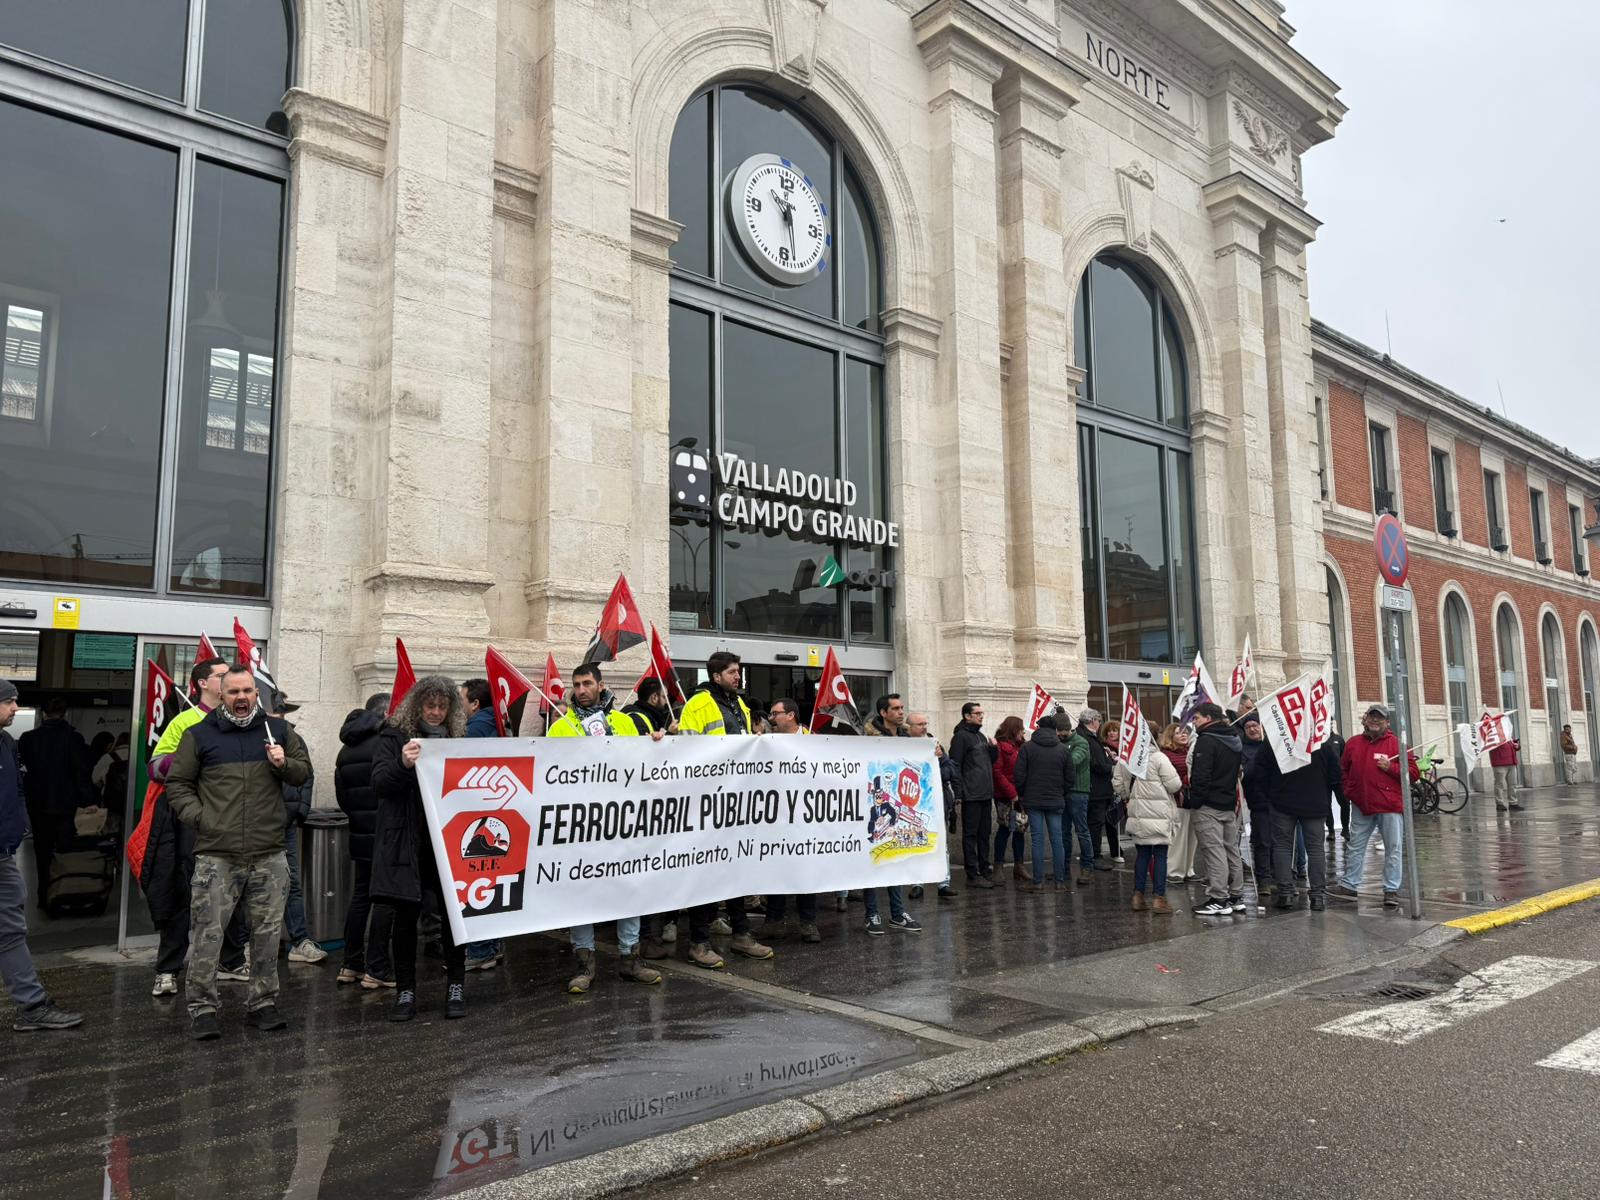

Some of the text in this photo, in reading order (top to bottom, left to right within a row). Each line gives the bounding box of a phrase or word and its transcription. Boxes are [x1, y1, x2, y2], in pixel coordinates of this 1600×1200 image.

[1086, 32, 1170, 111] NORTE
[779, 175, 795, 194] 12
[751, 198, 762, 212] 9
[808, 224, 818, 239] 3
[779, 247, 790, 261] 6
[716, 455, 857, 506] VALLADOLID
[718, 493, 899, 547] CAMPO GRANDE
[1270, 704, 1284, 731] Castilla
[545, 756, 861, 788] Castilla y León necesitamos más y mejor
[901, 775, 919, 799] STOP
[537, 786, 864, 846] FERROCARRIL PÚBLICO Y SOCIAL
[536, 834, 862, 885] Ni desmantelamiento, Ni privatización
[454, 874, 519, 911] CGT
